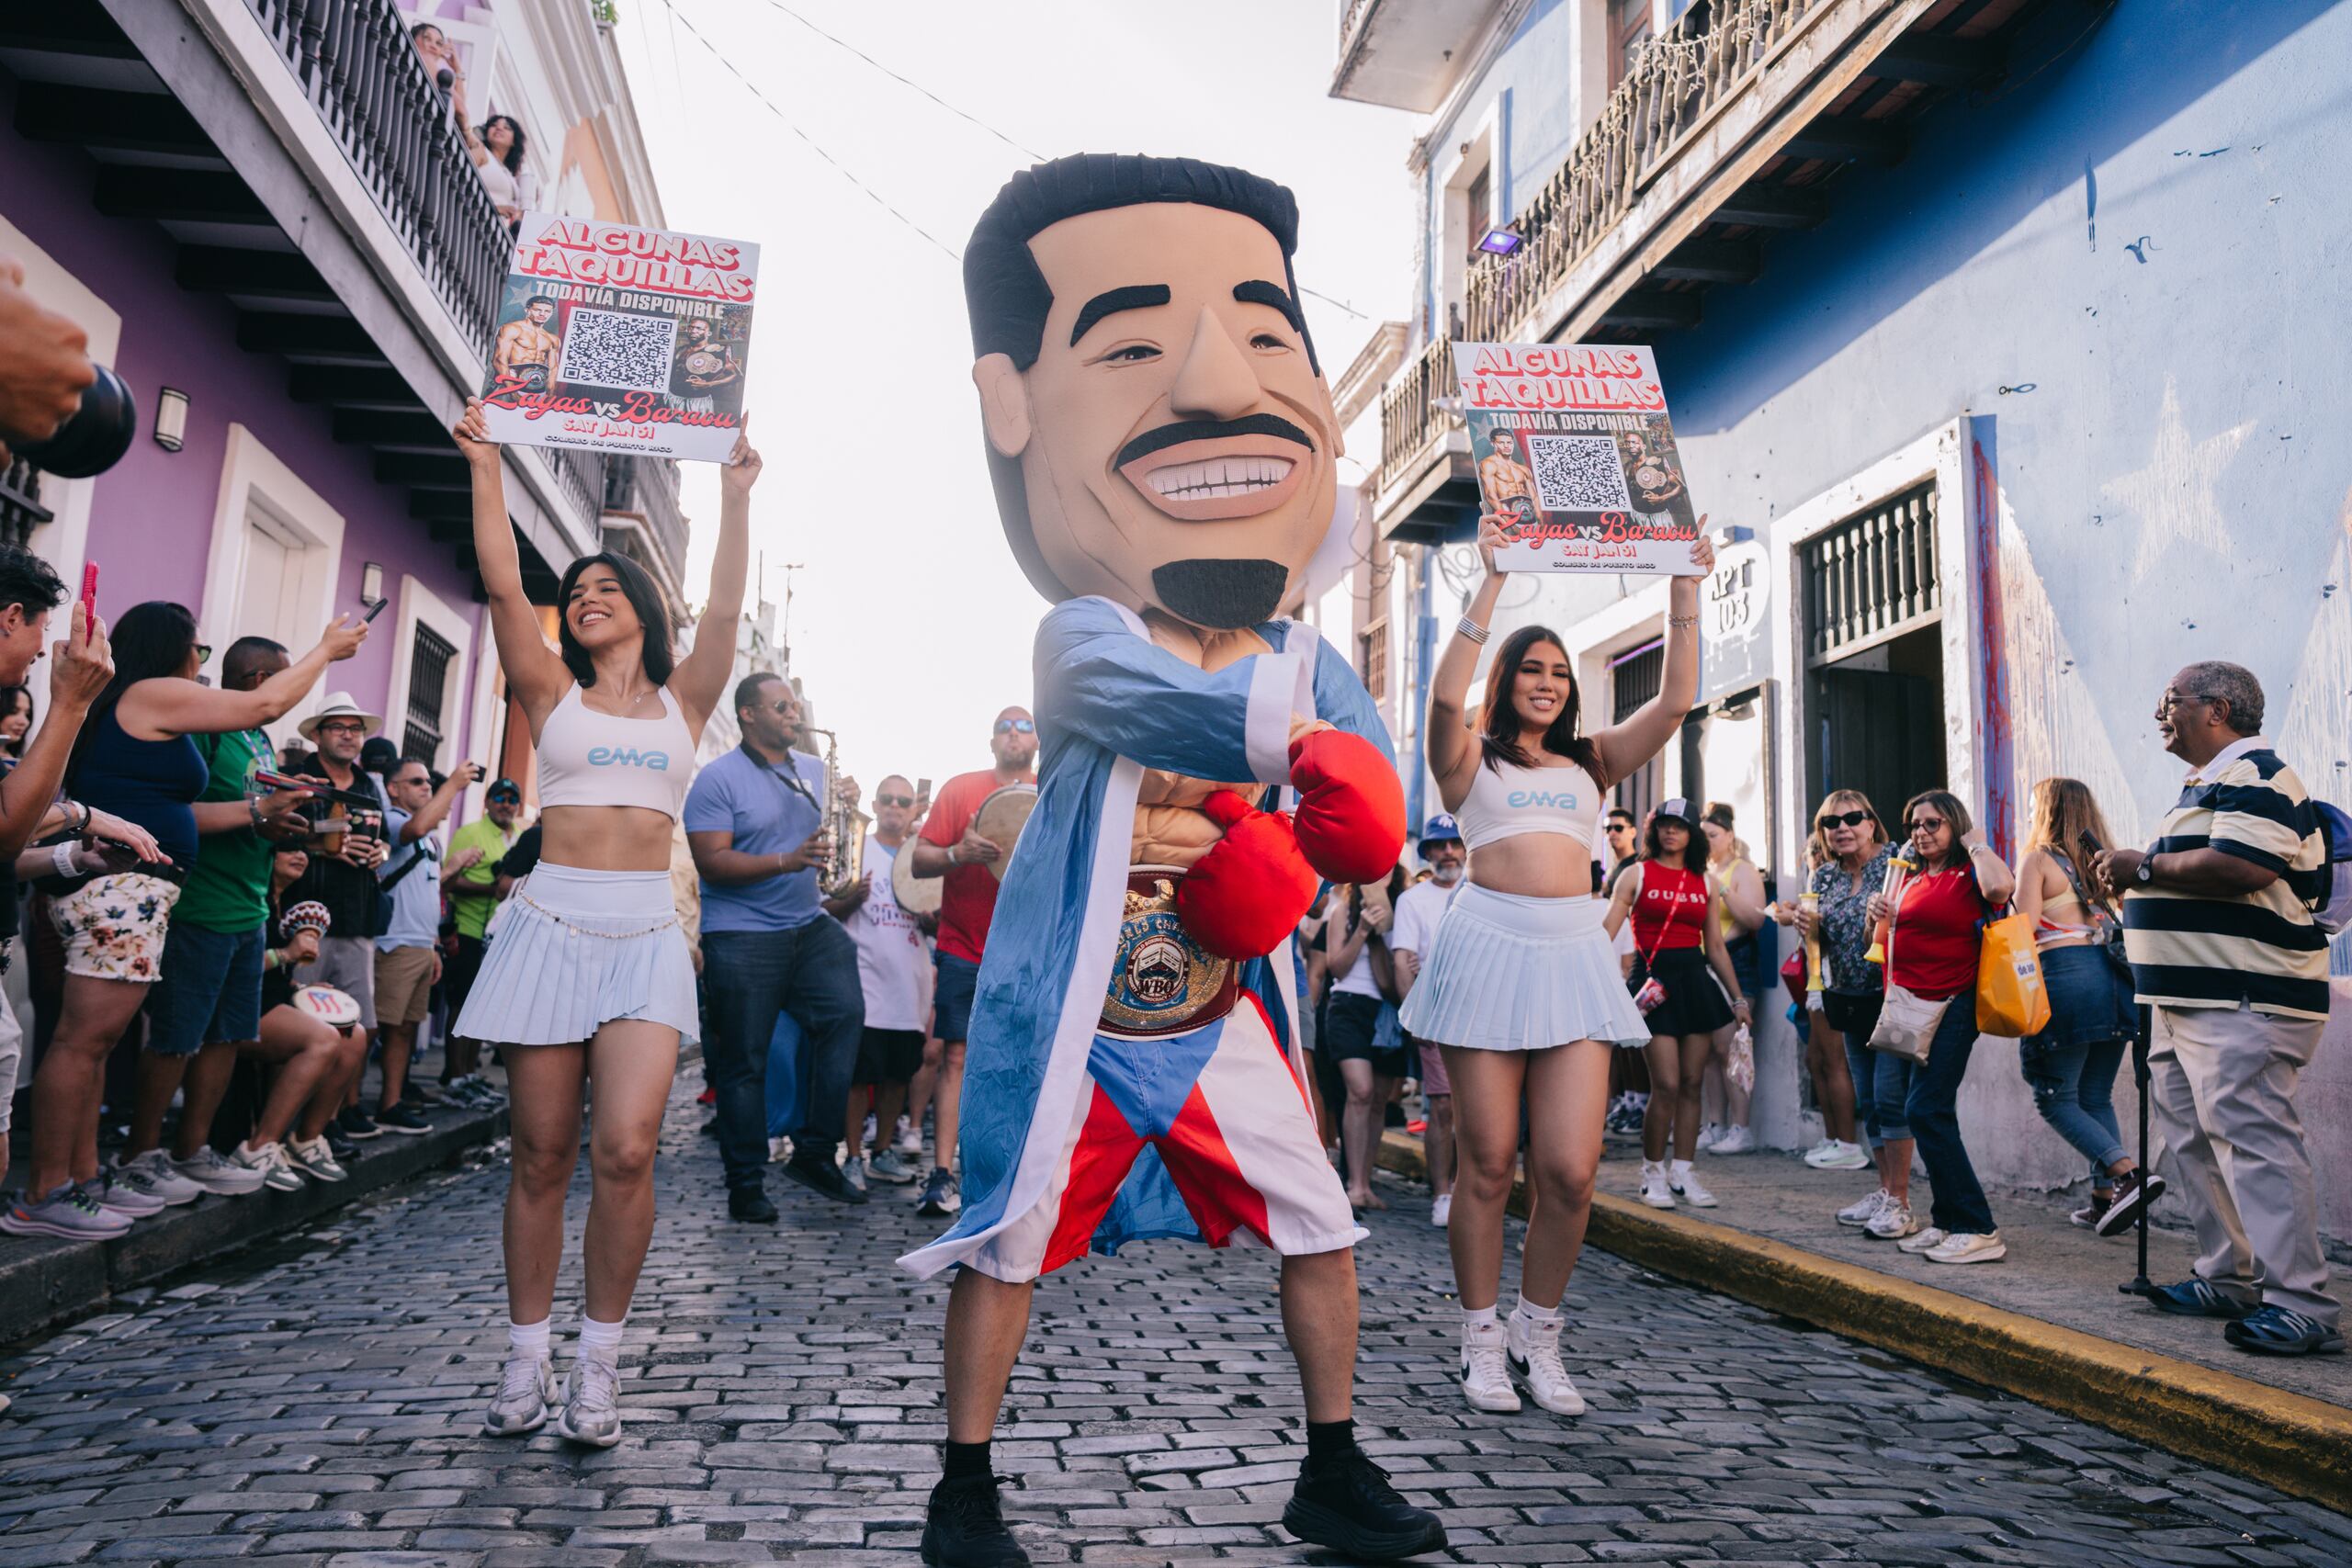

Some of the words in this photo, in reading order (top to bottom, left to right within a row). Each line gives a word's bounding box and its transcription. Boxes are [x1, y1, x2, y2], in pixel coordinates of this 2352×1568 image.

[537, 220, 741, 270] ALGUNAS
[518, 244, 754, 302] TAQUILLAS
[536, 280, 614, 307] TODAVÍA
[618, 291, 725, 320] DISPONIBLE
[1473, 347, 1643, 378] ALGUNAS
[482, 374, 596, 420] Zayas
[616, 391, 738, 429] Baraou
[1462, 377, 1666, 410] TAQUILLAS
[562, 418, 598, 434] SAT
[599, 422, 635, 438] JAN
[1489, 412, 1559, 431] TODAVÍA
[1562, 414, 1650, 431] DISPONIBLE
[545, 434, 589, 446] COLISEO
[591, 439, 605, 447] DE
[606, 442, 647, 451] PUERTO
[1495, 509, 1579, 549] Zayas
[1600, 511, 1698, 543] Baraou
[1553, 560, 1589, 569] COLISEO
[1635, 561, 1657, 570] RICO
[1561, 544, 1589, 557] SAT
[1593, 544, 1621, 559] JAN
[1709, 558, 1755, 602] APT
[1647, 889, 1706, 905] GUESS
[1139, 978, 1175, 995] WBO
